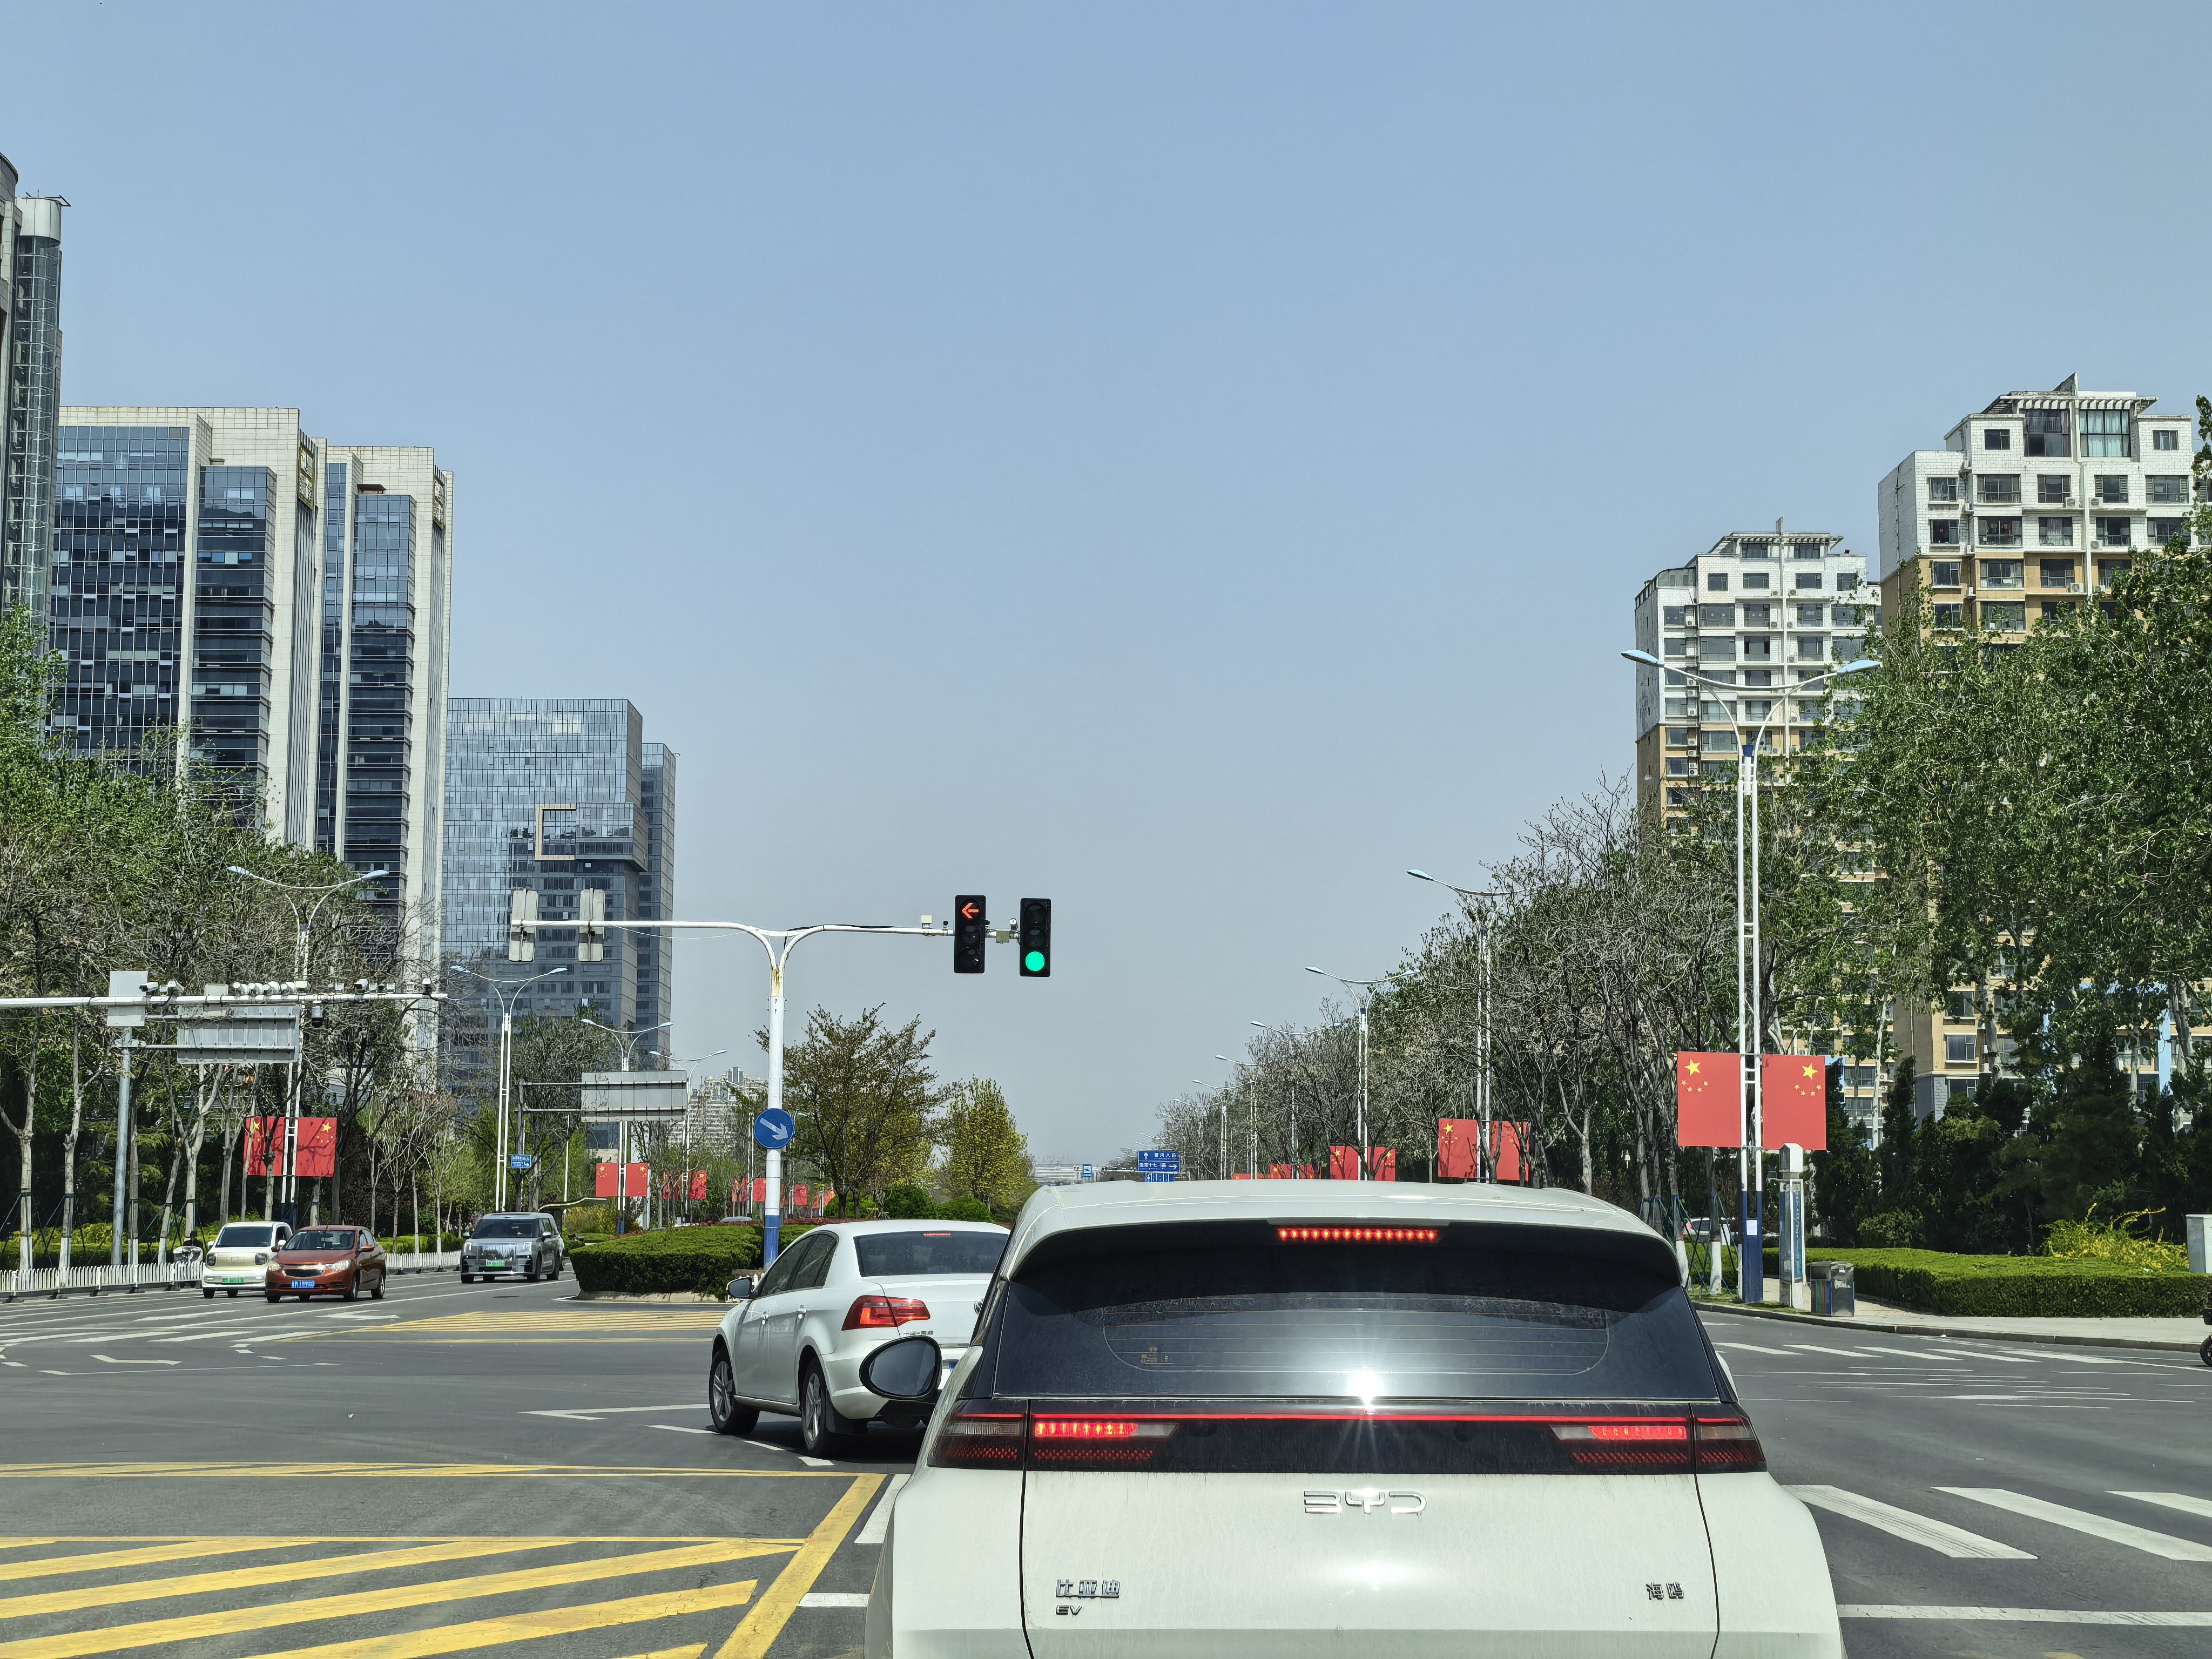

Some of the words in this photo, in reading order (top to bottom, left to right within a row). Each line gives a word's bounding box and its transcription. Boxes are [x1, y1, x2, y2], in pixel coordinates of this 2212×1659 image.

[1304, 1491, 1427, 1514] BYD
[1056, 1579, 1120, 1598] 比亚迪
[1645, 1582, 1684, 1600] 海鸥
[1056, 1605, 1082, 1615] EV
